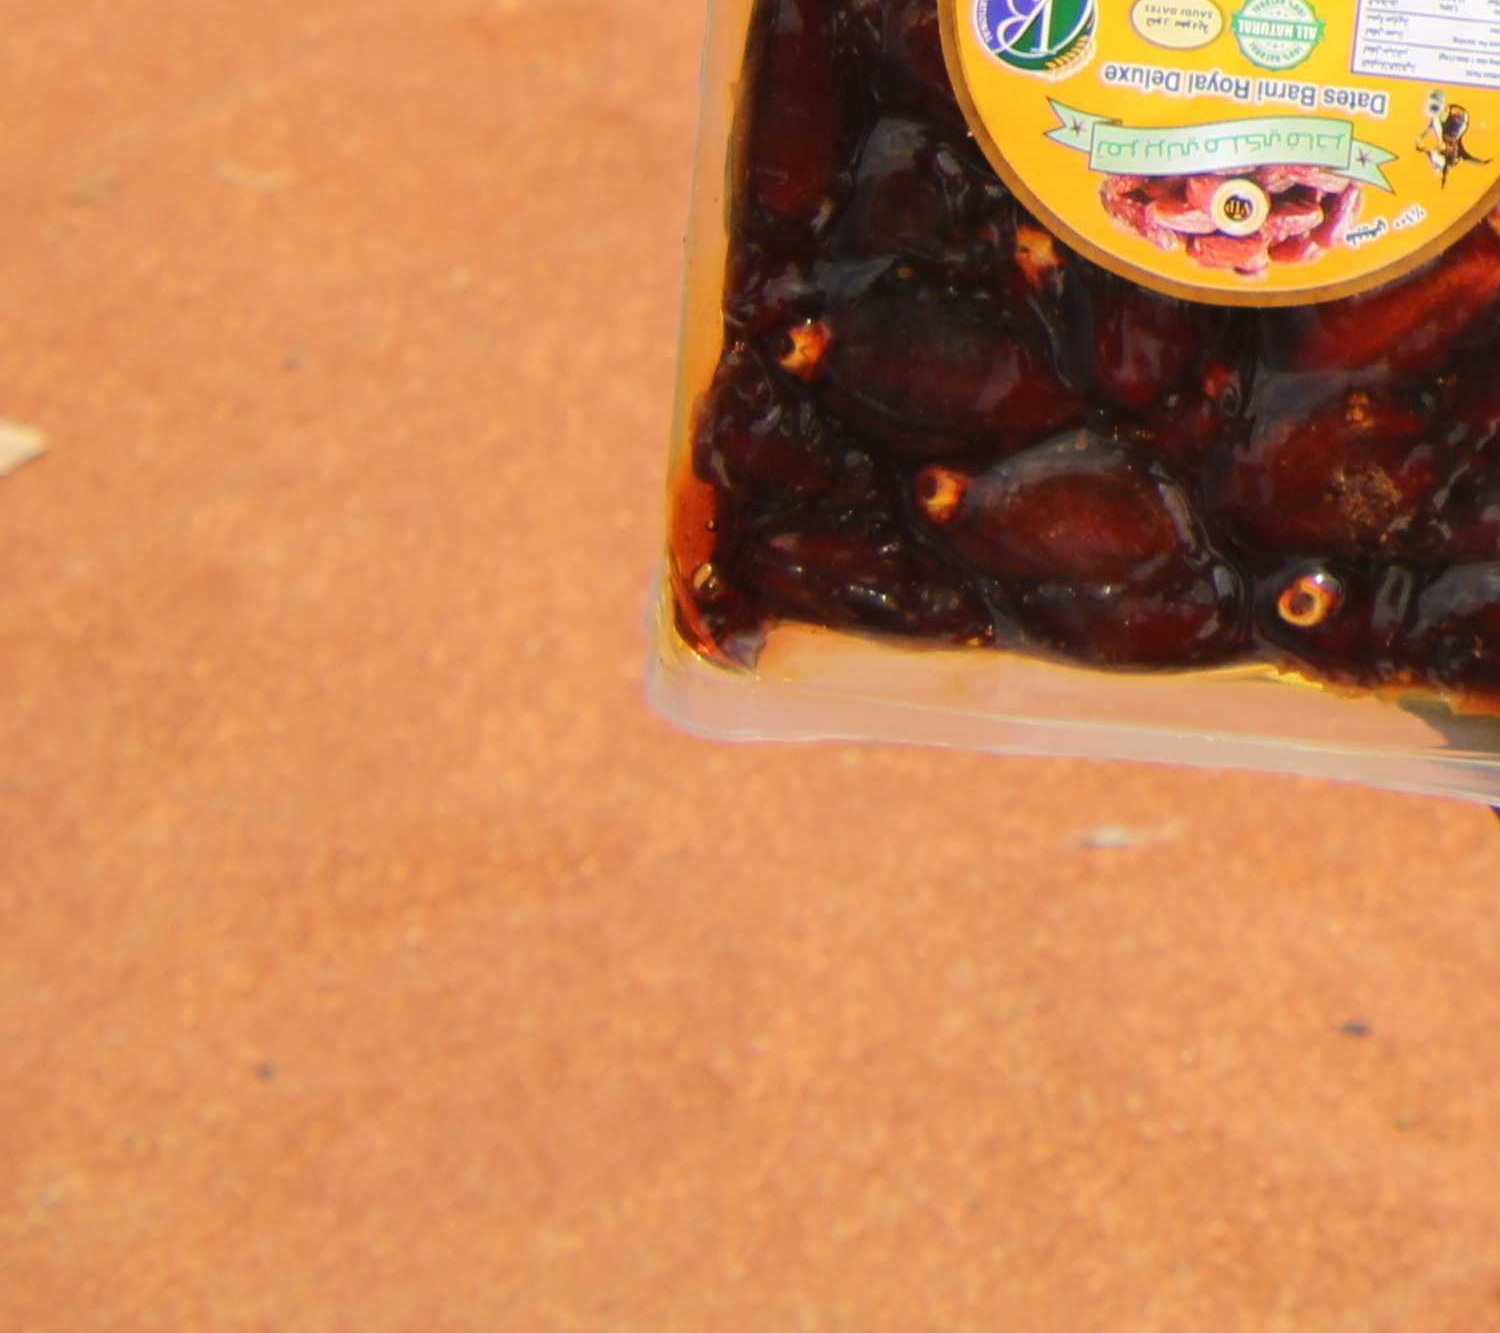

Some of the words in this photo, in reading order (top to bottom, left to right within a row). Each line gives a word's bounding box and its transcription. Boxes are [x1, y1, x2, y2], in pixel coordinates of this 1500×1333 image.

[1145, 5, 1177, 15] DATES
[1181, 9, 1212, 19] SAUDI
[1239, 20, 1294, 37] NATURAL
[1296, 25, 1317, 40] ALL
[1104, 65, 1181, 91] Deluxe
[1188, 71, 1250, 99] Royal
[1258, 81, 1315, 107] Barni
[1324, 89, 1386, 115] Dates
[1098, 139, 1139, 159] تمر
[1225, 200, 1250, 217] VIP
